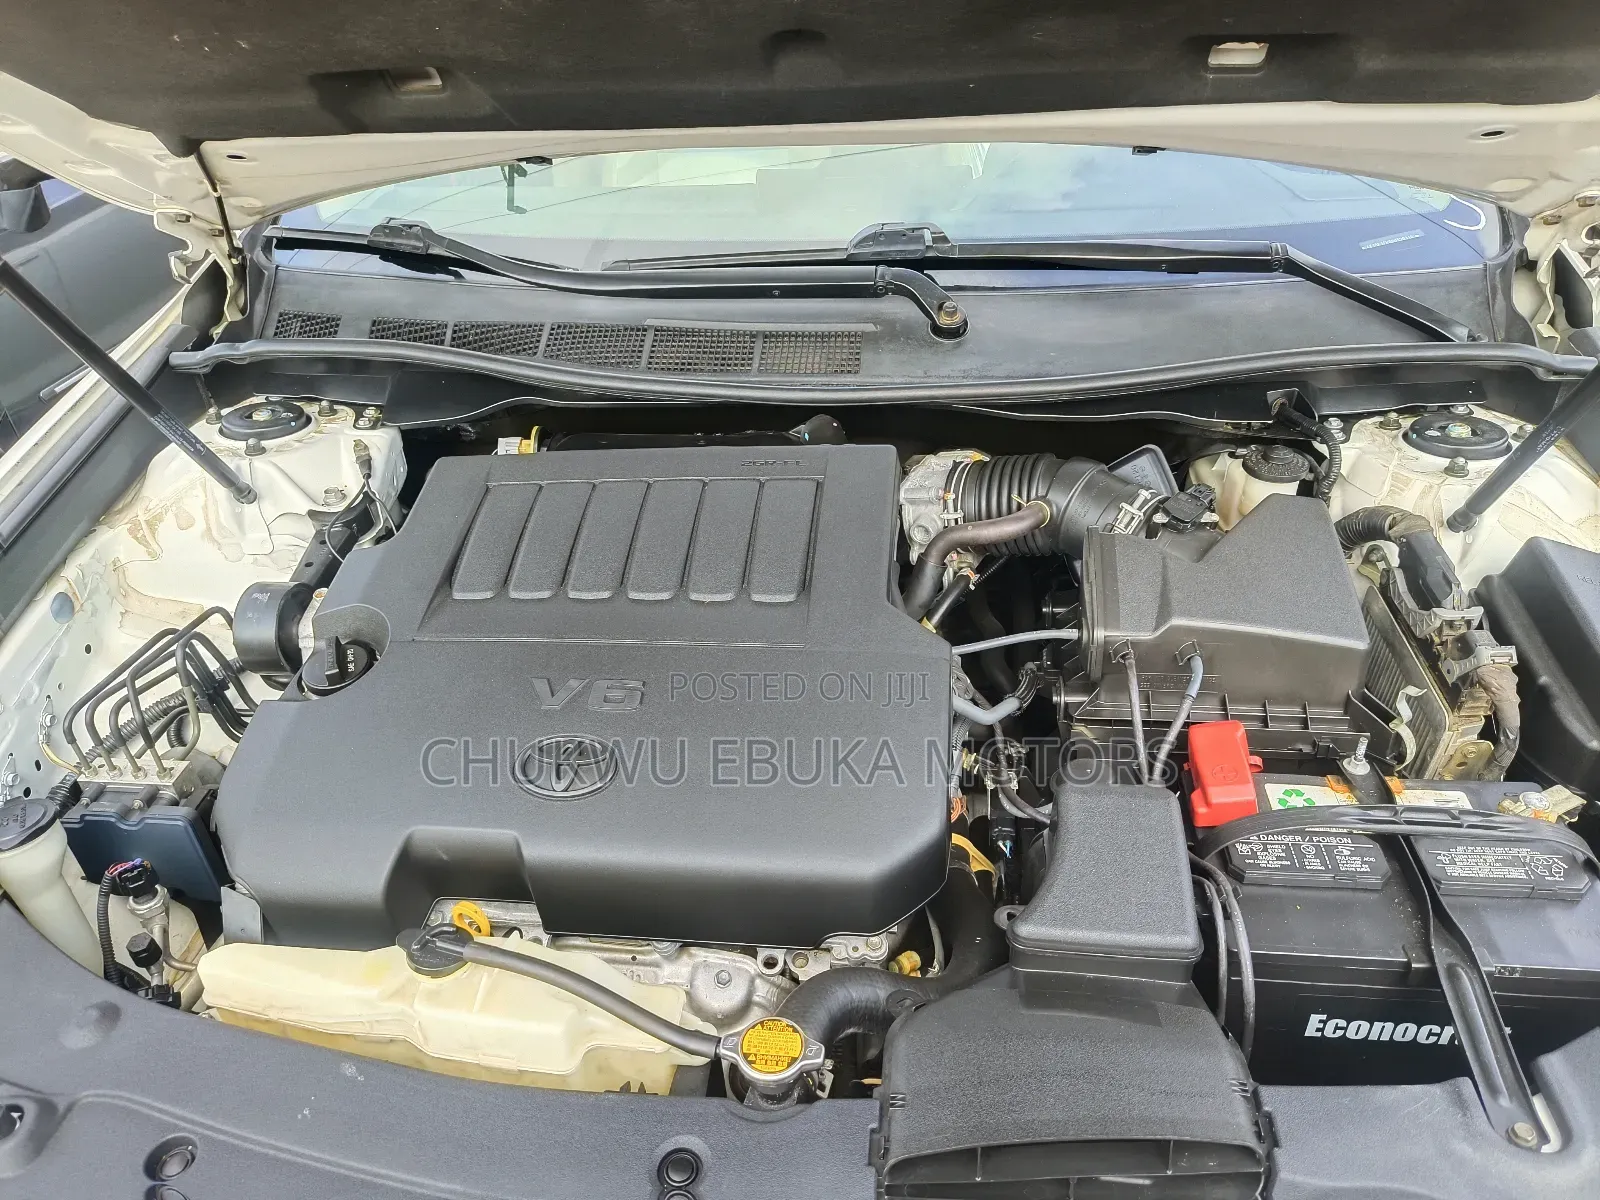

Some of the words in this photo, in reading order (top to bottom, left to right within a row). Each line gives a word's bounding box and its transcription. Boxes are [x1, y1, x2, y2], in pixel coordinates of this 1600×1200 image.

[531, 677, 647, 711] V6
[1260, 834, 1302, 842] DANGER
[1312, 836, 1352, 844] POISON
[1304, 1013, 1512, 1045] Econocr
